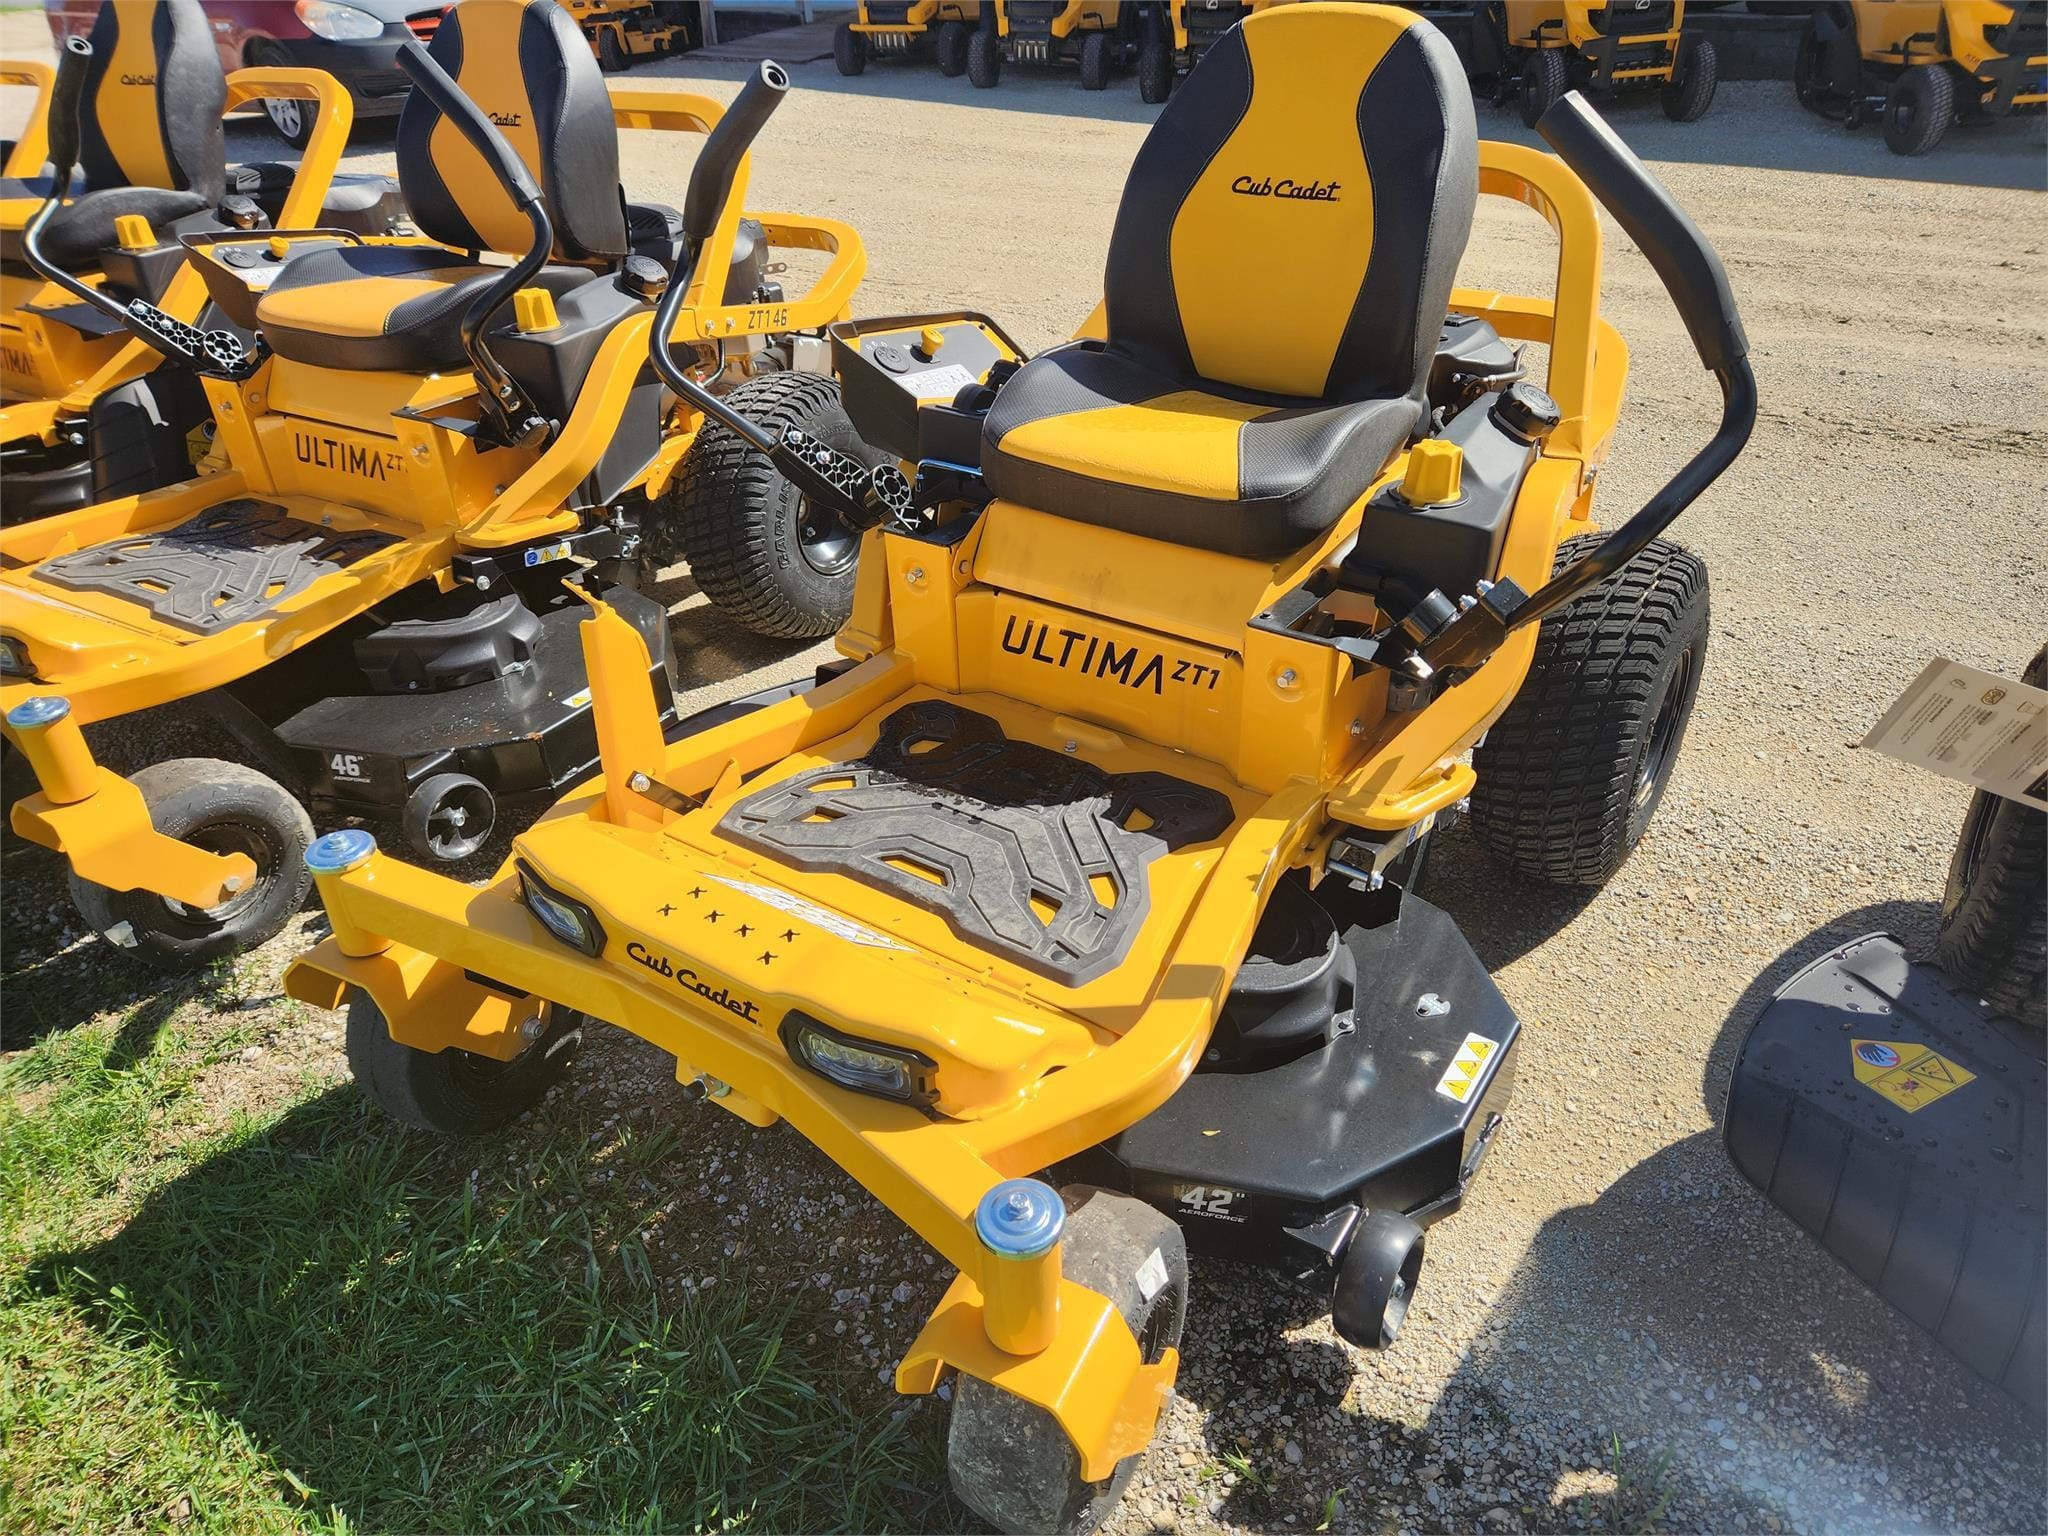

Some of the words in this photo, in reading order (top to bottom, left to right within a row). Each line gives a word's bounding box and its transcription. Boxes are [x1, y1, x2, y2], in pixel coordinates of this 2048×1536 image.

[489, 112, 521, 127] Cadet
[1232, 176, 1272, 196] Cub
[1274, 180, 1341, 201] Cadet
[295, 432, 386, 482] ULTIMA
[386, 453, 408, 473] ZT
[1001, 614, 1164, 695] ULTIMA
[1170, 659, 1221, 690] ZT1
[330, 753, 364, 776] 46"
[626, 942, 674, 978] Cub
[676, 969, 760, 1025] Cadet
[1181, 1186, 1246, 1215] 42"
[1178, 1208, 1247, 1224] AEROFORCE
